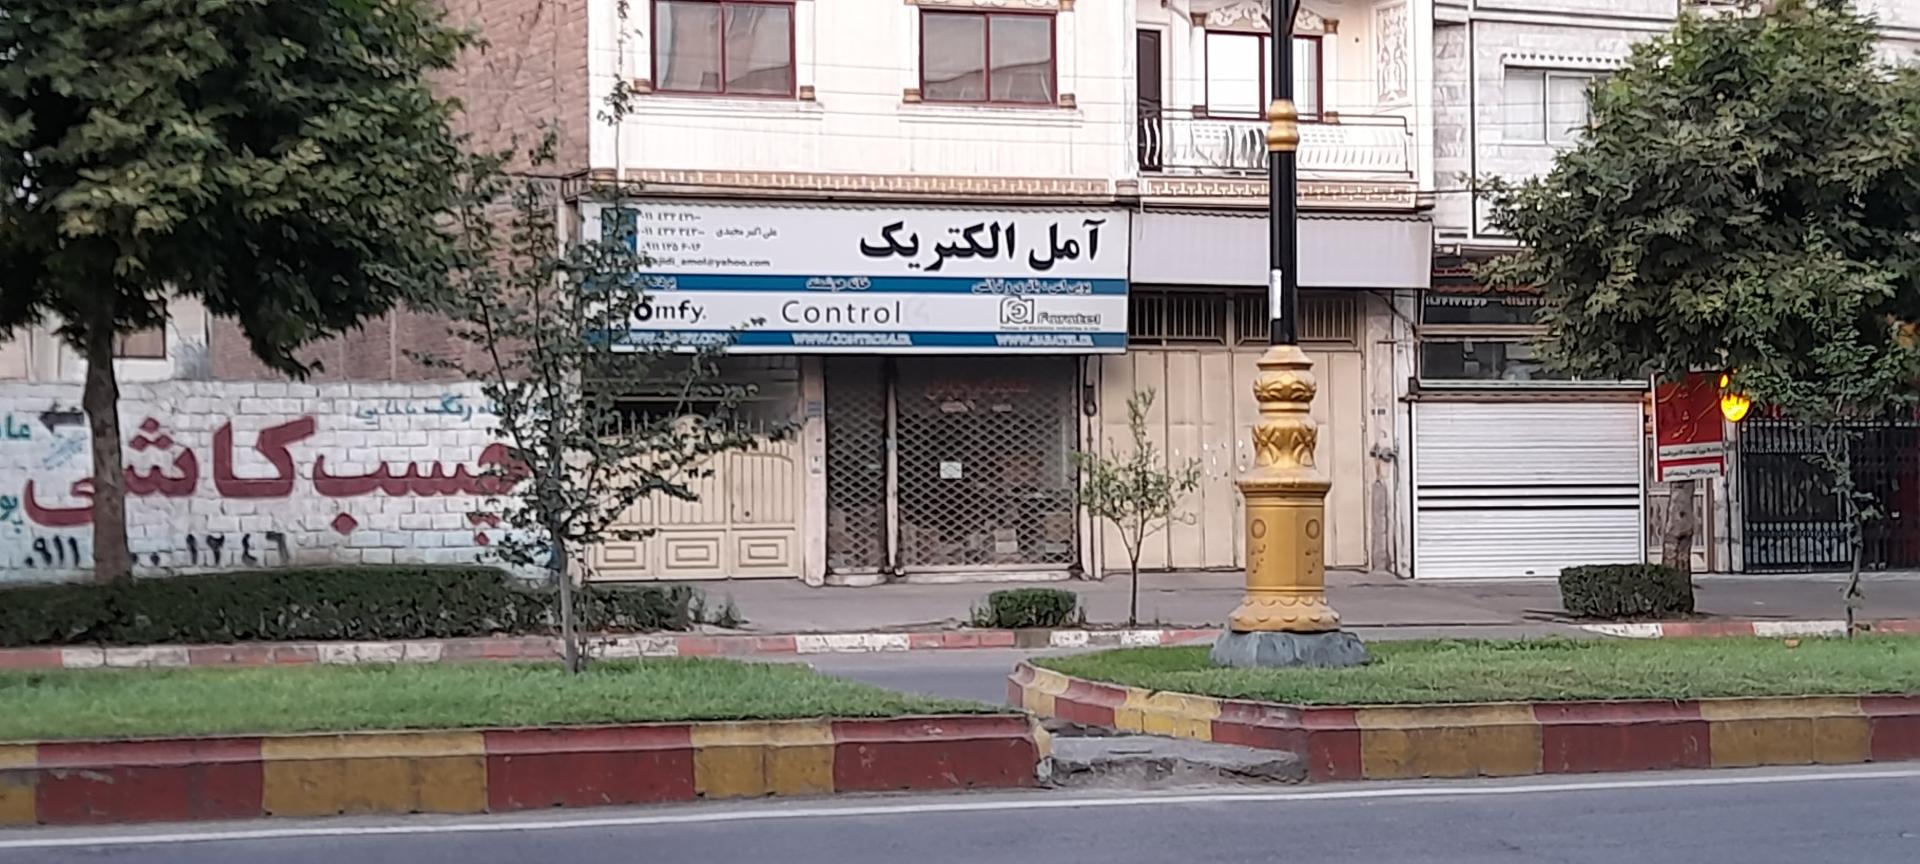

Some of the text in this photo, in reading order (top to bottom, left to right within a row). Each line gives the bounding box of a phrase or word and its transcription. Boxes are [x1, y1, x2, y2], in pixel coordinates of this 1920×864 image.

[745, 226, 762, 239] اکبر
[763, 227, 777, 240] علی
[860, 218, 1106, 272] آمل الکتریک
[1037, 312, 1101, 325] Faratel
[422, 396, 472, 423] رنگ
[23, 415, 530, 546] چسب کاشی
[24, 535, 80, 568] ۰۹۱۱
